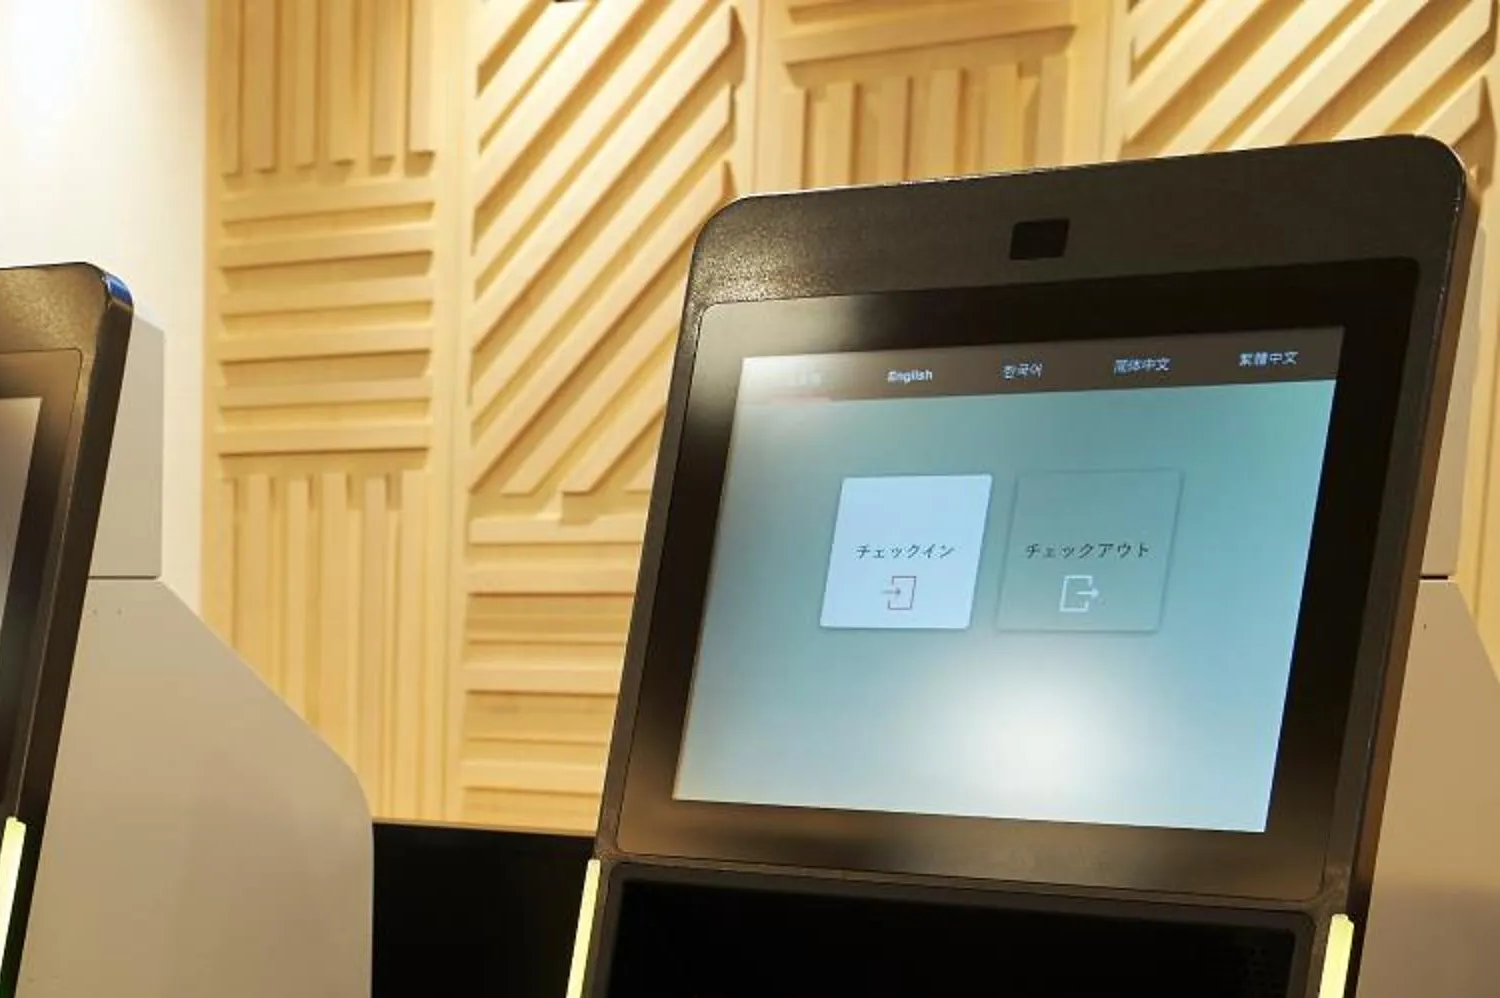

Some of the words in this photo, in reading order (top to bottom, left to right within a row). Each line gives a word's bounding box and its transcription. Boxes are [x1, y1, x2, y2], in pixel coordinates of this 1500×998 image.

[887, 368, 933, 385] English
[1003, 362, 1043, 380] 한국어
[855, 543, 956, 560] チェックイン
[1026, 541, 1150, 559] チェックアウト
